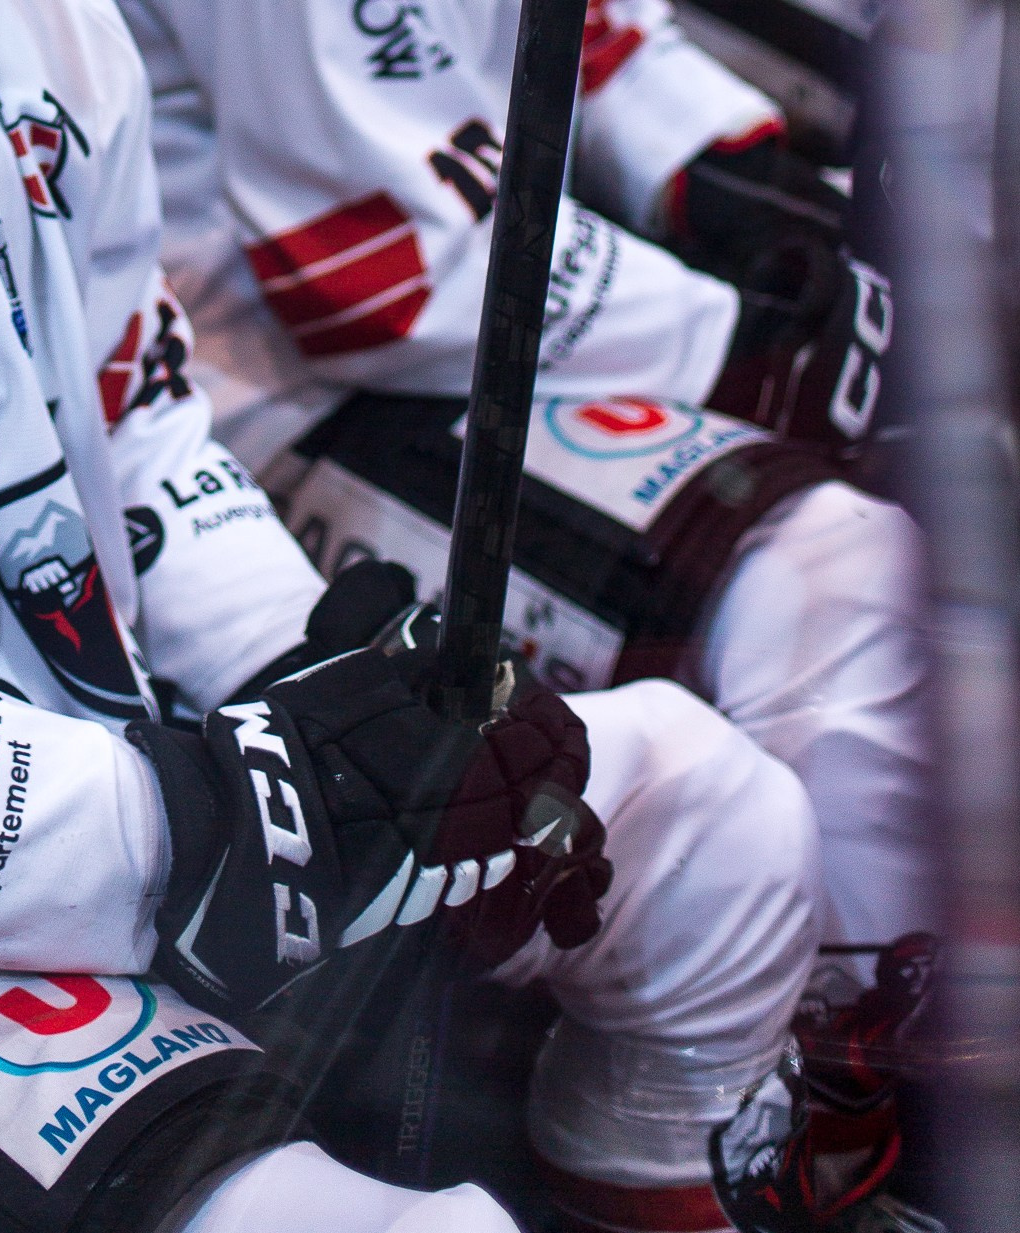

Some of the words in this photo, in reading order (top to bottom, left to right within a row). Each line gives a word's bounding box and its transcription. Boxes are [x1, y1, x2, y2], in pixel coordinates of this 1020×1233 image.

[160, 469, 225, 508] La
[218, 700, 322, 963] CCM
[37, 1021, 233, 1157] MAGLAND
